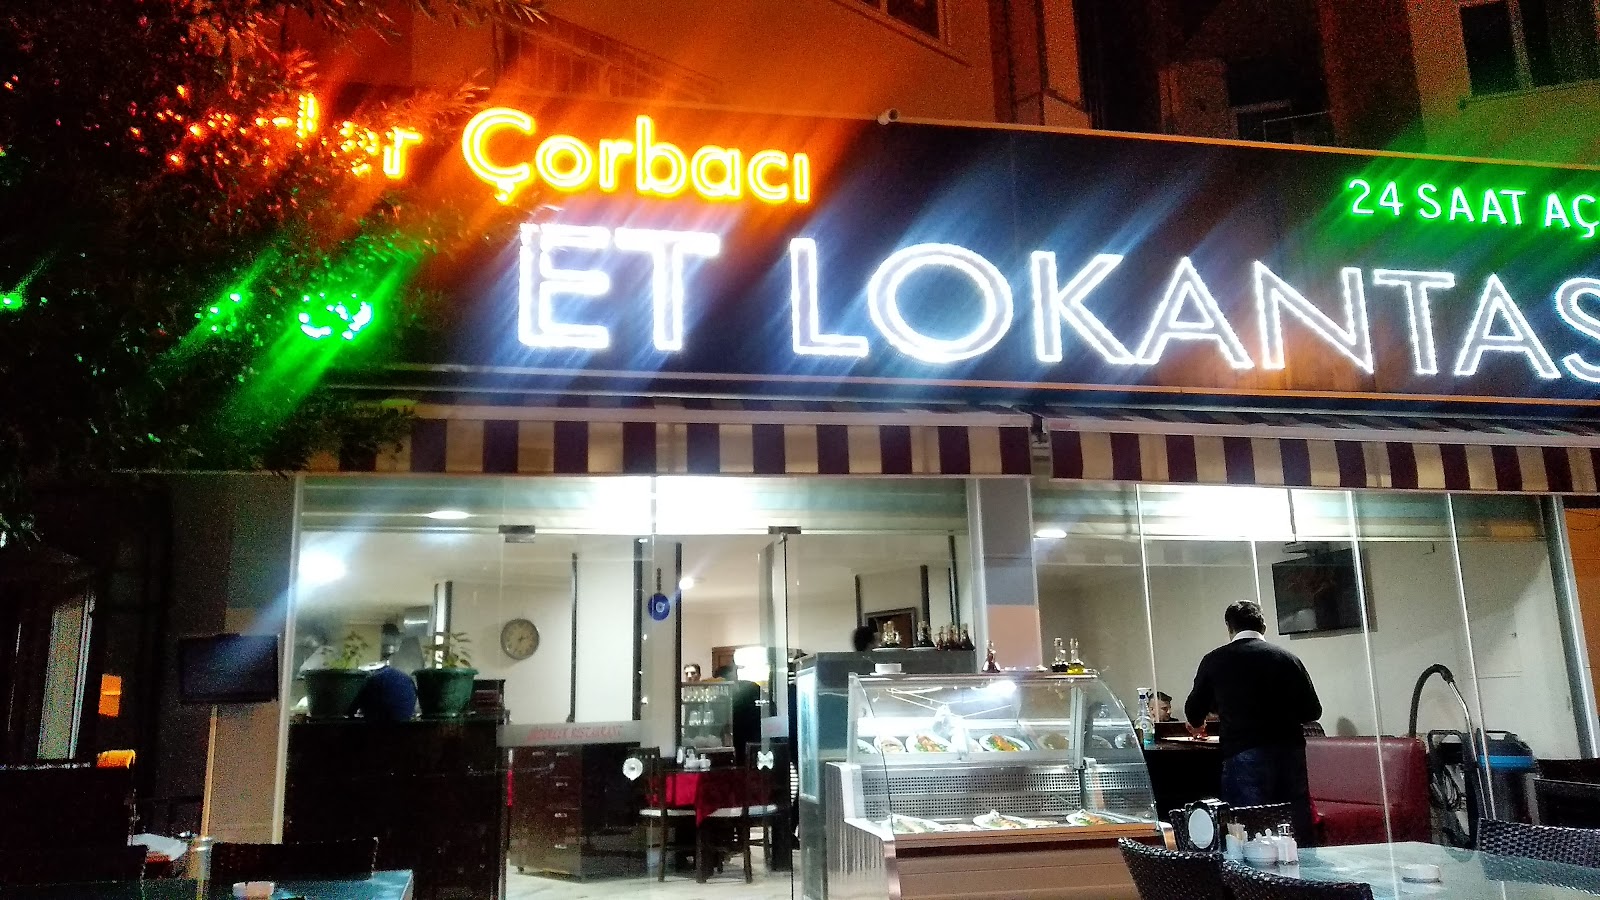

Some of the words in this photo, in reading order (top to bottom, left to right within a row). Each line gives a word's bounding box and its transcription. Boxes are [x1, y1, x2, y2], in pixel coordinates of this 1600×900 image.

[462, 107, 810, 203] Çorbacı
[1347, 178, 1404, 216] 24
[1417, 183, 1527, 226] SAAT
[517, 223, 721, 351] ET
